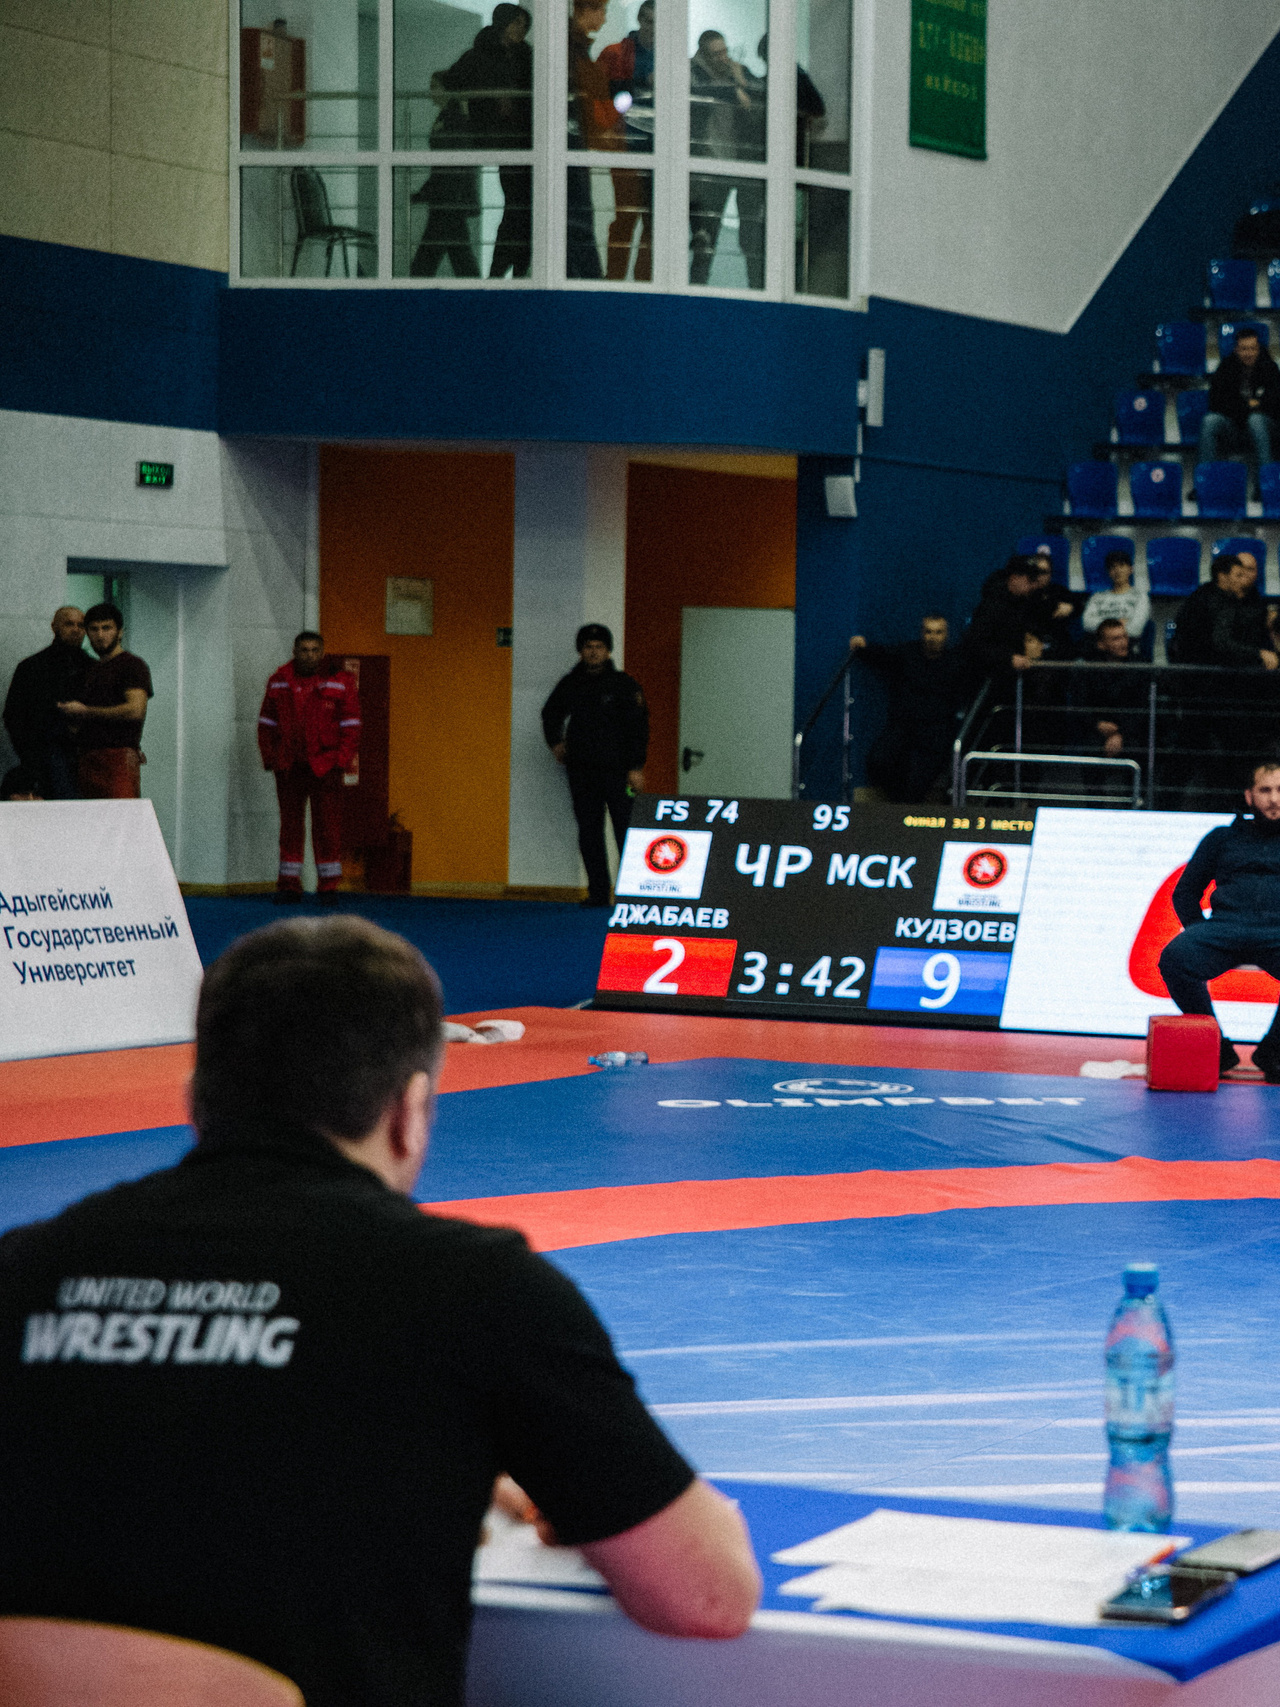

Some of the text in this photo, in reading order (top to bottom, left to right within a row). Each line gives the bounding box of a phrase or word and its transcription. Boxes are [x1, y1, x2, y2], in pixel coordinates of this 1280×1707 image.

[656, 799, 739, 824] FS 74
[812, 804, 851, 831] 95
[952, 818, 970, 829] за
[976, 816, 986, 829] 3
[991, 820, 1034, 831] место
[735, 843, 917, 889] ЧР МСК
[608, 903, 729, 929] ДЖАБАЕВ
[895, 917, 1017, 944] КУДЗОЕВ
[3, 915, 180, 953] Государственный
[12, 958, 136, 986] Университет
[643, 938, 686, 995] 2
[737, 951, 866, 999] 3:42
[918, 952, 962, 1009] 9
[58, 1277, 282, 1311] UNITED WORLD
[22, 1311, 301, 1367] WRESTLING
